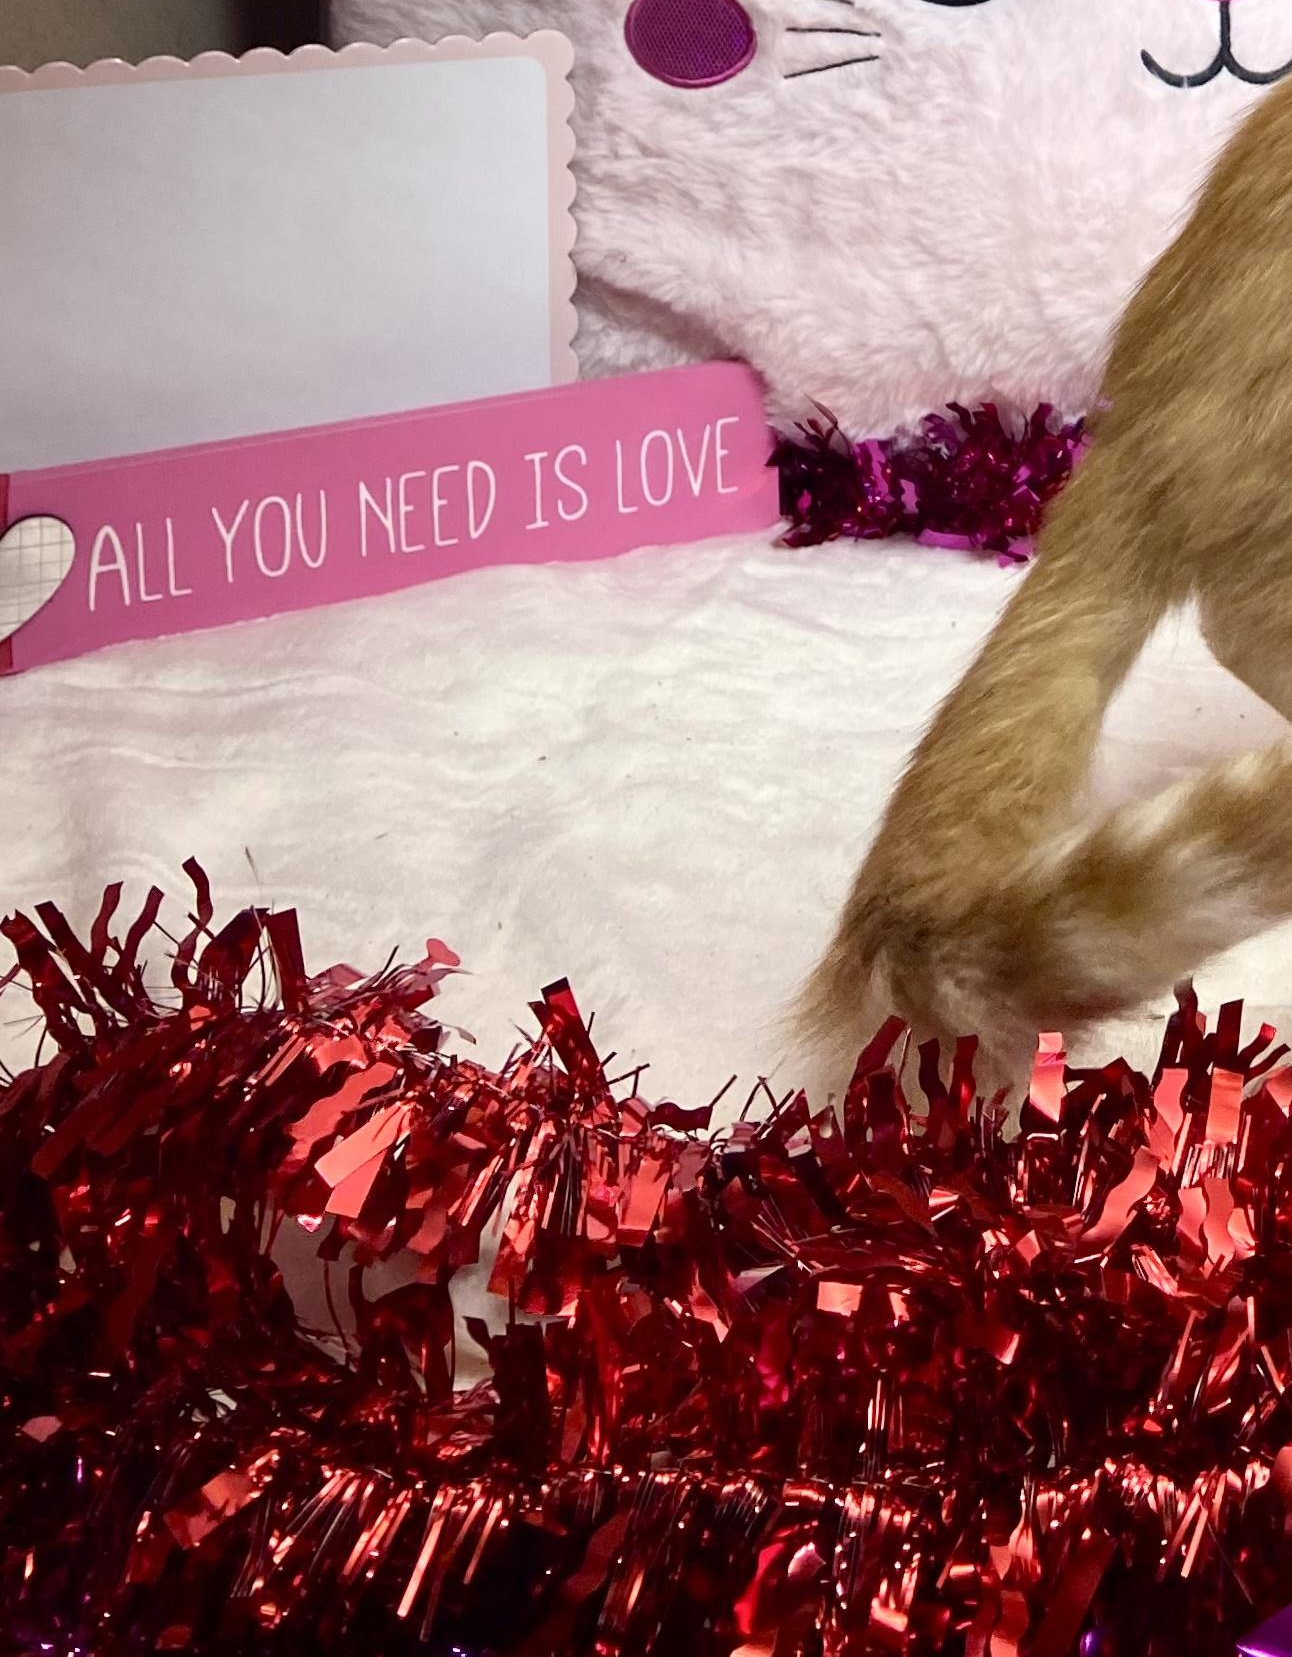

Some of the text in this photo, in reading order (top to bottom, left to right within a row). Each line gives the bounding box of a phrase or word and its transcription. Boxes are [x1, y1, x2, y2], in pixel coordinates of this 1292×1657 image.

[88, 416, 741, 612] ALL YOU NEED IS LOVE
